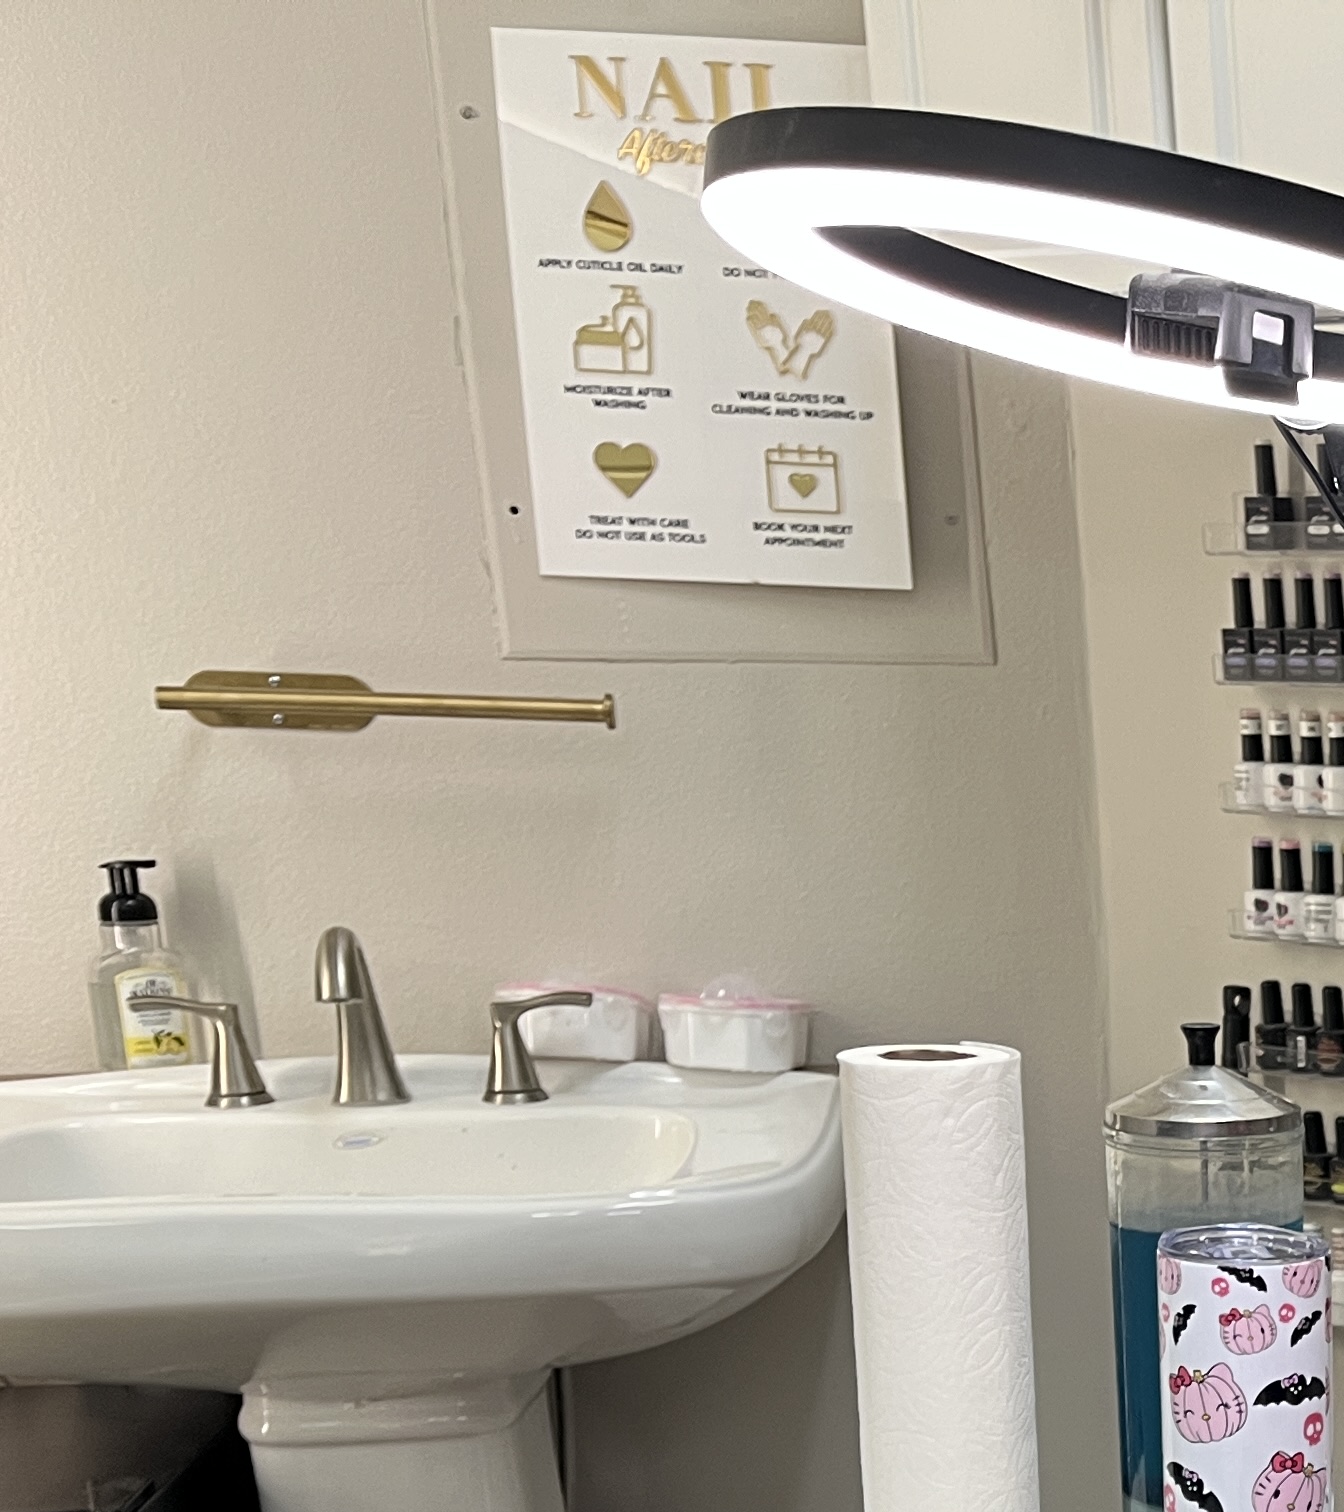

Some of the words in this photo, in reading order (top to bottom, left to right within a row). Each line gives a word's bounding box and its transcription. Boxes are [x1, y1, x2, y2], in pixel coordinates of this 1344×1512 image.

[538, 258, 572, 269] APPLY
[576, 260, 623, 271] CUTICLE
[627, 261, 647, 272] OIL
[651, 262, 683, 274] DAILY
[723, 266, 741, 277] DO
[564, 384, 633, 396] MOISTURIZE
[637, 387, 671, 398] AFTER
[592, 399, 646, 410] WASHING
[738, 391, 770, 402] WEAR
[774, 392, 819, 404] GLOVES
[823, 395, 846, 405] FOR
[711, 404, 771, 416] CLEANING
[775, 407, 799, 417] AND
[804, 408, 856, 420] WASHING
[589, 515, 623, 526] TREAT
[627, 516, 657, 527] WITH
[660, 517, 689, 528] CARE
[753, 522, 784, 533] BOOK
[789, 523, 819, 534] YOUR
[823, 524, 853, 535] NEXT
[575, 529, 593, 540] DO
[597, 530, 621, 541] NOT
[625, 531, 646, 542] USE
[650, 532, 664, 542] AS
[668, 532, 706, 544] TOOLS
[763, 536, 845, 548] APPOINTMENT
